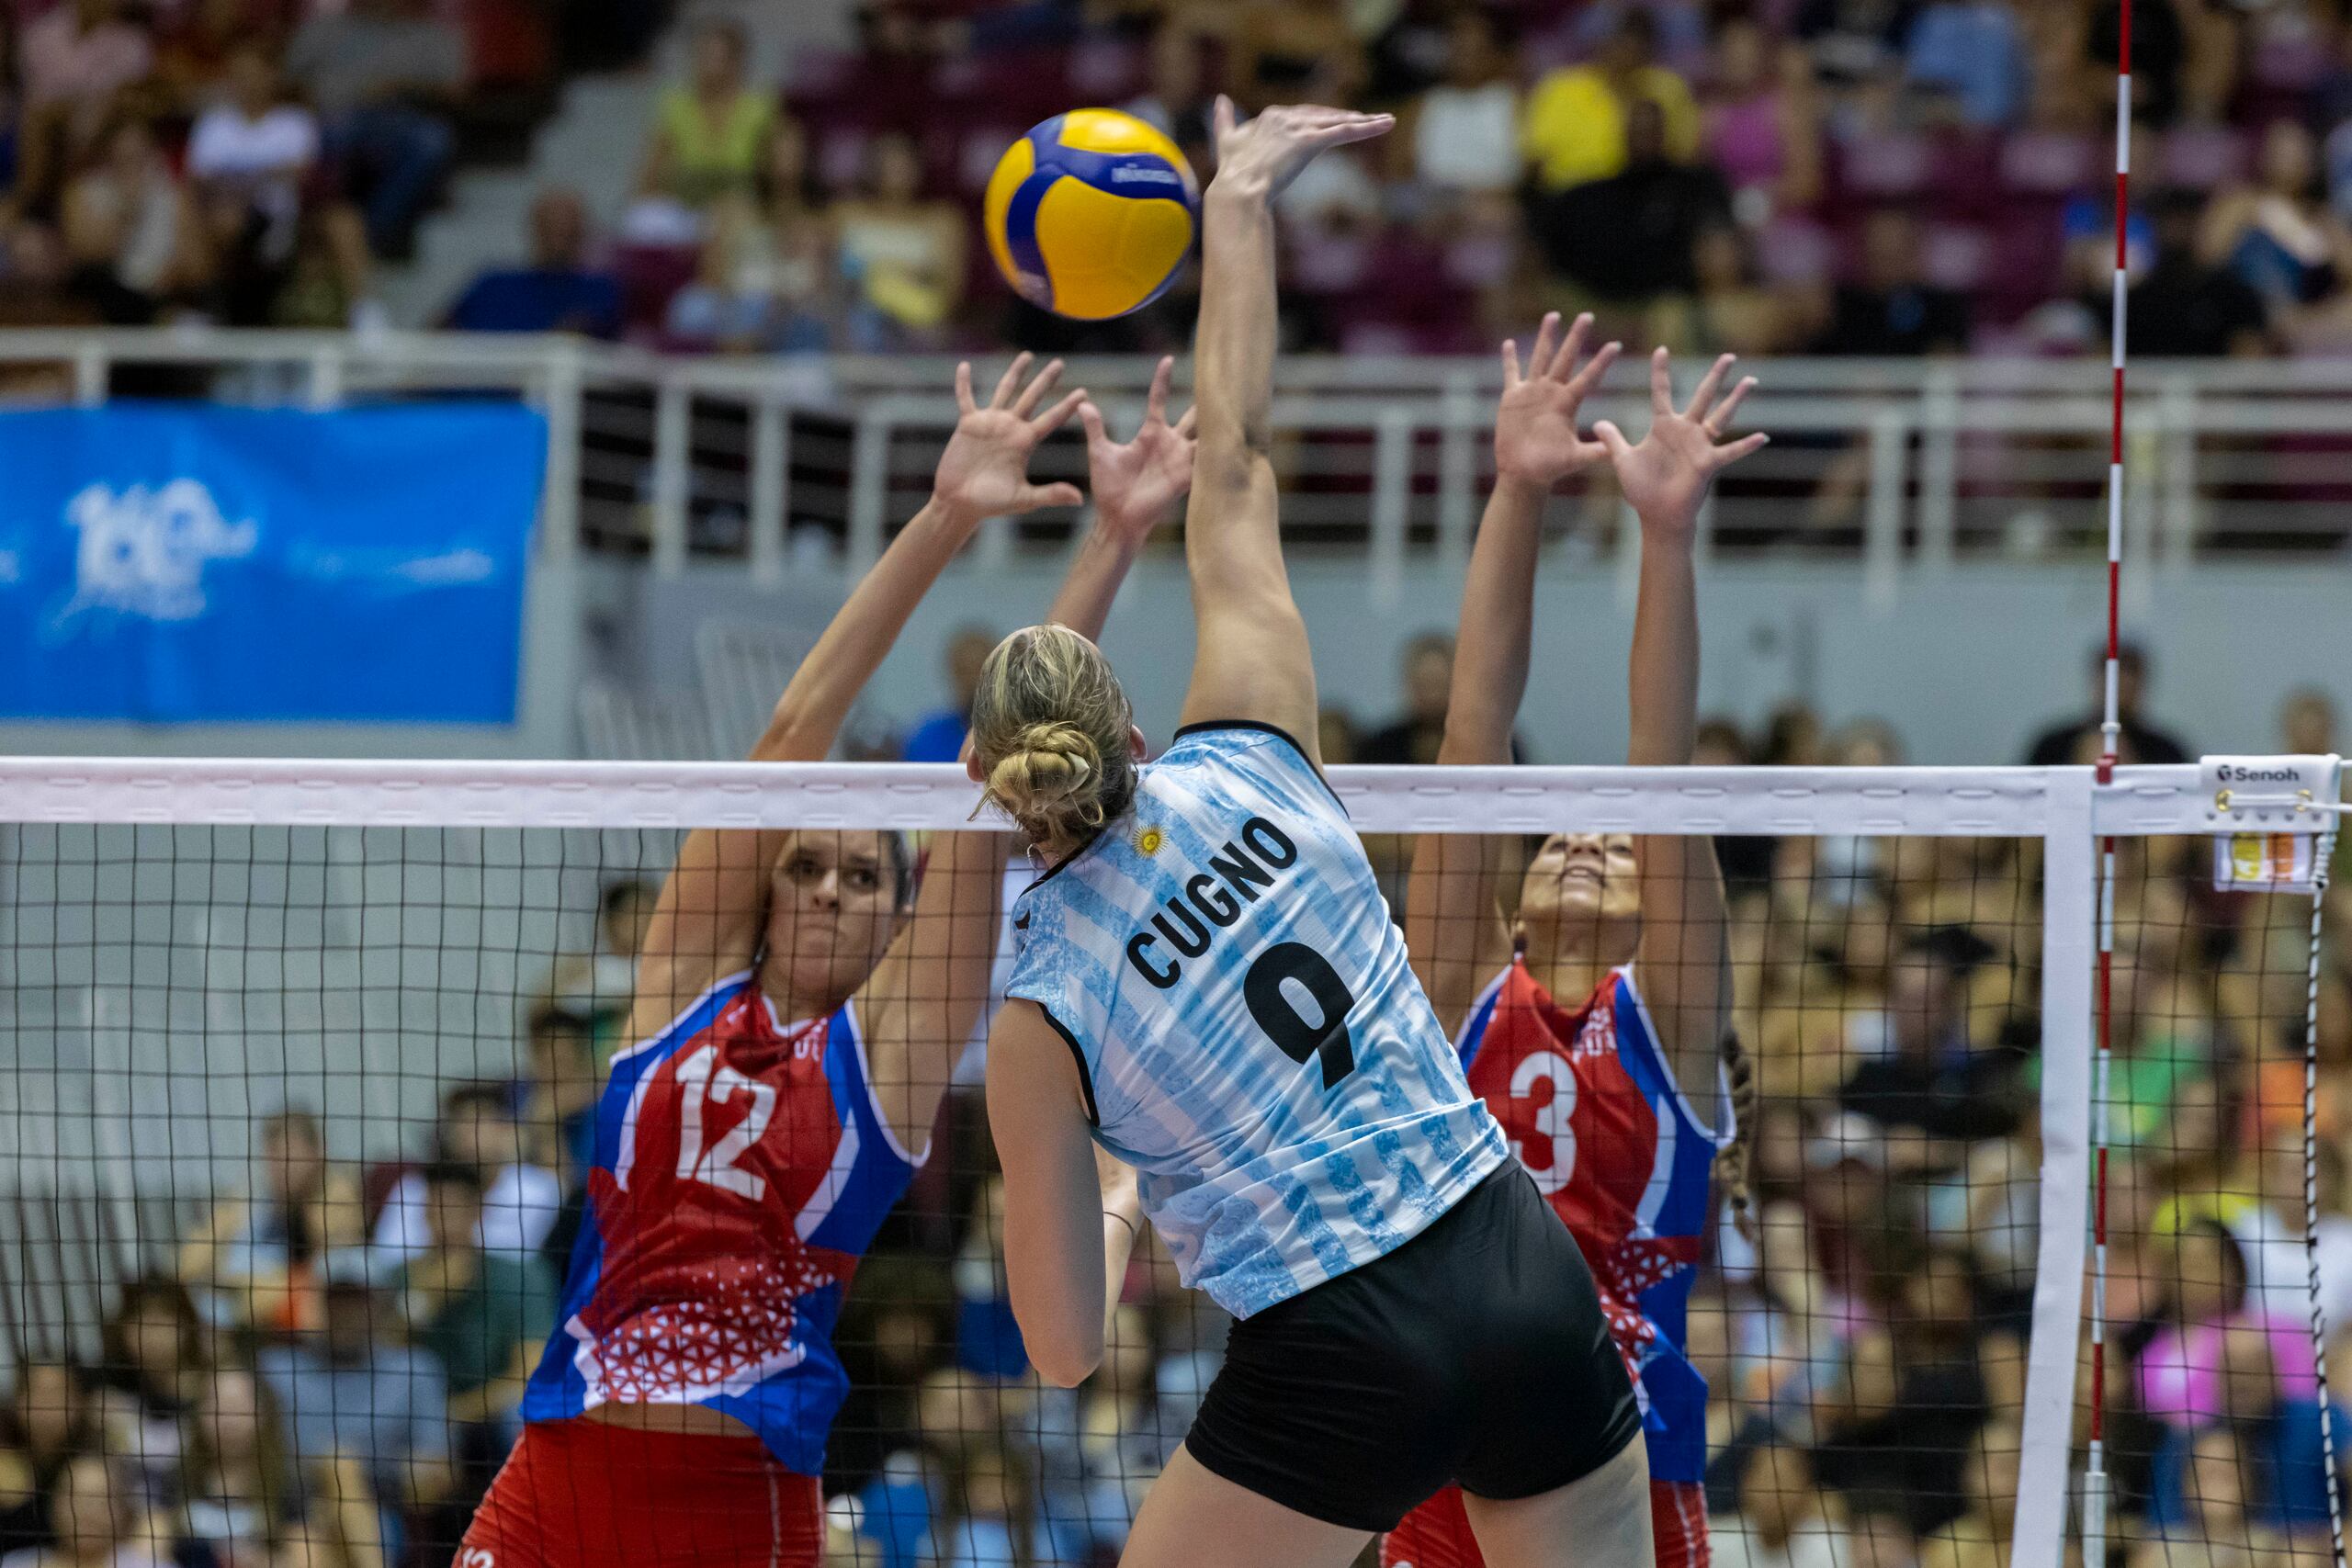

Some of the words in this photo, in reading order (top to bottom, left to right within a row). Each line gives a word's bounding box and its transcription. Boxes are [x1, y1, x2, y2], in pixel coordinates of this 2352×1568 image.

[2234, 766, 2300, 781] Senoh
[1126, 817, 1297, 989] CUGNO
[1243, 942, 1355, 1092] 9
[676, 1044, 776, 1201] 12
[1510, 1051, 1577, 1195] 3
